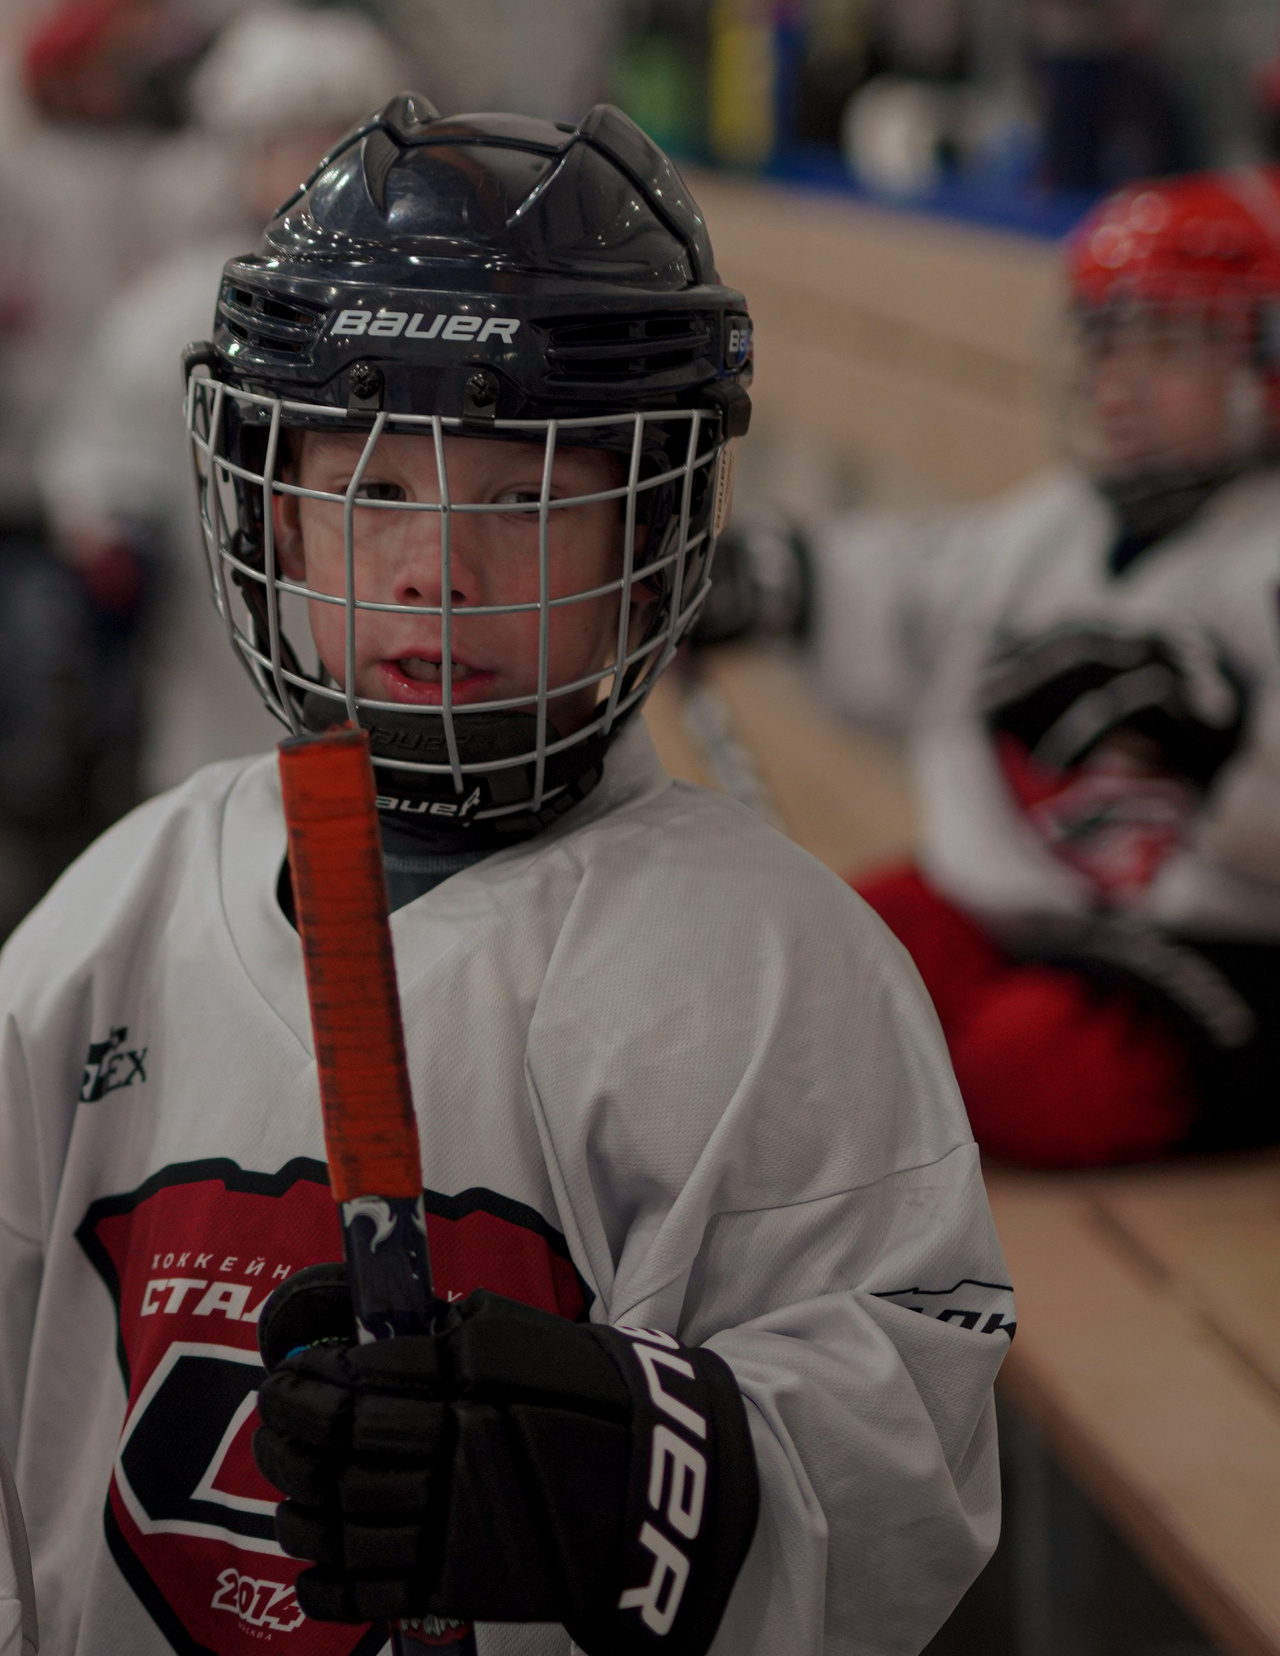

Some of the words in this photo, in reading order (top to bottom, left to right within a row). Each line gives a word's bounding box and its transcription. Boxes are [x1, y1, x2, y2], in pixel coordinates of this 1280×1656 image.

[151, 1251, 292, 1280] ХОККЕЙН
[613, 1325, 711, 1638] AUER
[210, 1567, 308, 1633] 2014
